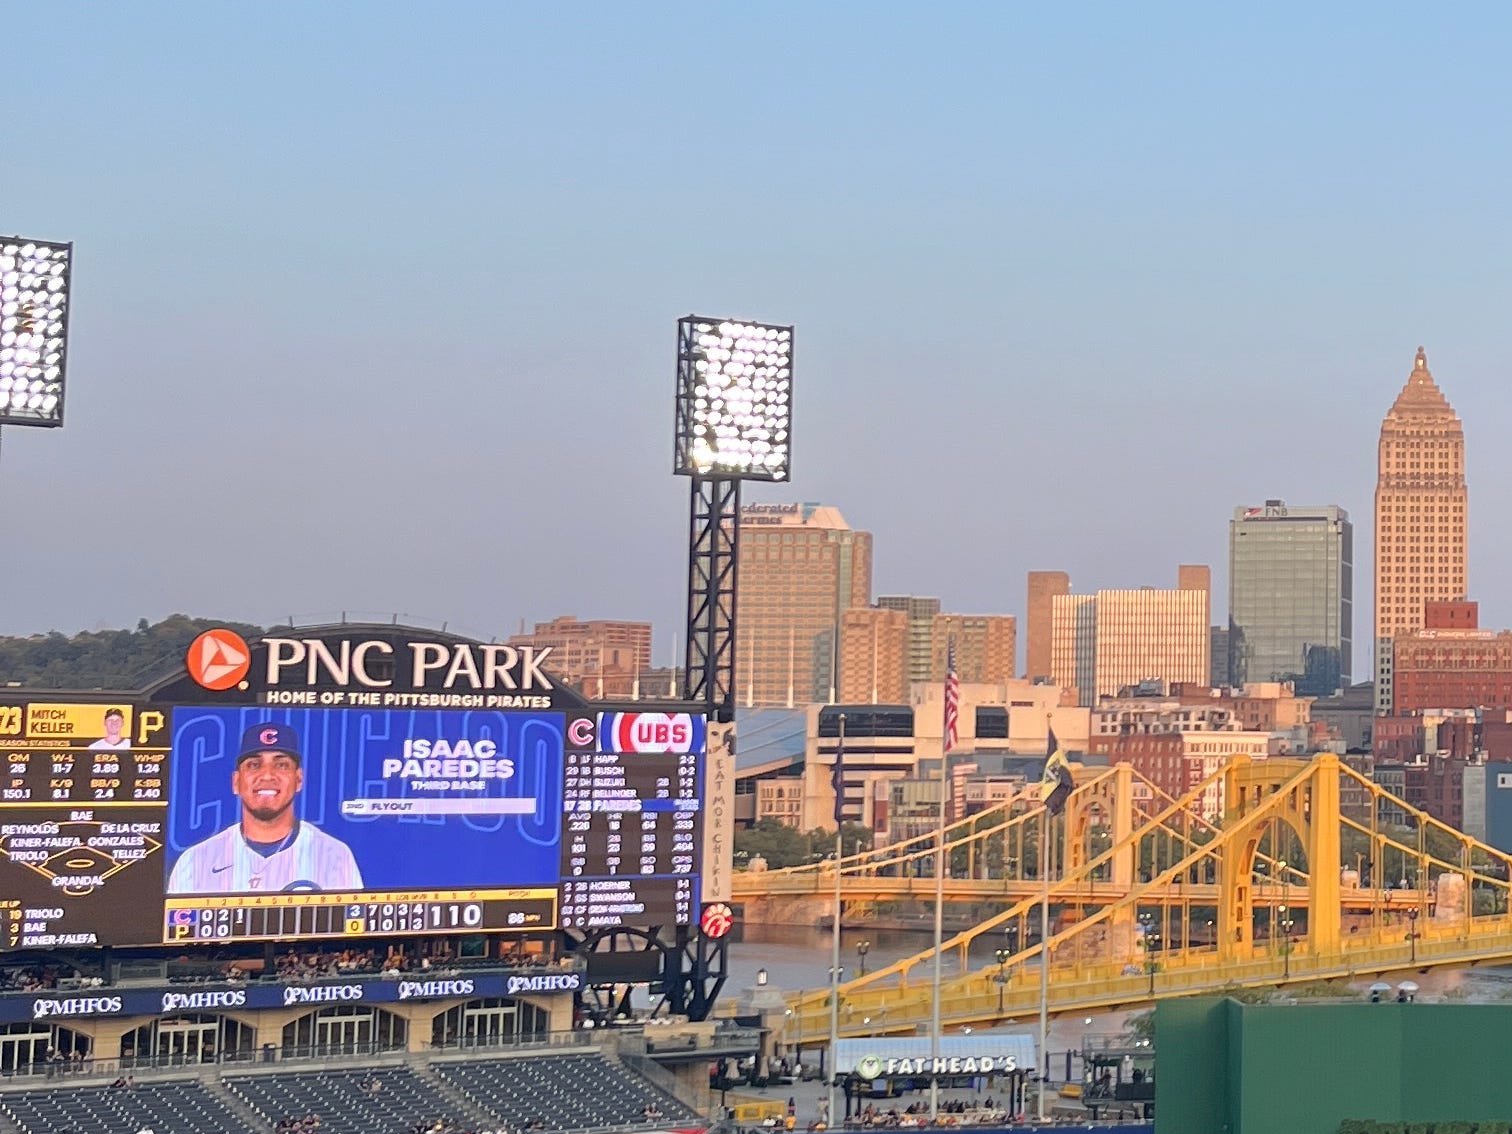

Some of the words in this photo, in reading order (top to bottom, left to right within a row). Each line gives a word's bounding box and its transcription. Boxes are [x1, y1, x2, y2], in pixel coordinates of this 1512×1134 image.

[261, 637, 394, 687] PNC
[407, 641, 554, 690] PARK
[266, 690, 317, 704] HOME
[320, 691, 344, 705] OF
[348, 692, 381, 705] THE
[384, 693, 483, 708] PITTSBURGH
[486, 695, 551, 709] PIRATES
[30, 709, 66, 720] MITCH
[30, 722, 74, 734] KELLER
[138, 710, 165, 744] P
[568, 718, 595, 746] C
[260, 728, 279, 745] C
[403, 739, 497, 758] ISAAC
[8, 753, 30, 763] GM
[94, 753, 118, 763] ERA
[133, 754, 165, 762] WHIP
[593, 755, 619, 763] HAPP
[679, 755, 695, 764] 2-2
[137, 764, 160, 774] 1.24
[382, 759, 515, 778] PAREDES
[565, 767, 579, 775] 29
[593, 766, 625, 775] BUSCH
[678, 766, 695, 775] 0-2
[714, 759, 725, 791] EAT
[410, 780, 450, 790] THIRD
[451, 780, 486, 790] BASE
[565, 778, 579, 787] 27
[593, 778, 626, 787] SUZUKI
[2, 789, 31, 799] 150.1
[94, 789, 114, 799] 2.4
[133, 789, 161, 799] 3.40
[592, 789, 637, 798] BELLINGER
[371, 802, 413, 811] FLYOUT
[712, 797, 725, 827] MOR
[71, 811, 94, 821] BAE
[1, 824, 59, 835] REYNOLDS
[101, 824, 117, 834] DE
[117, 824, 130, 833] LA
[132, 823, 161, 833] CRUZ
[10, 837, 81, 847] KINER-FALEFA
[87, 836, 145, 846] GONZALES
[9, 851, 49, 861] TRIOLO
[112, 849, 147, 859] TELLEZ
[51, 876, 105, 886] GRANDAL
[564, 882, 572, 891] 2
[588, 892, 636, 903] SWANSON
[25, 909, 64, 919] TRIOLO
[174, 909, 192, 924] C
[201, 909, 213, 922] 0
[218, 909, 229, 921] 2
[235, 909, 243, 924] 1
[350, 905, 360, 916] 3
[369, 904, 378, 916] 7
[383, 904, 393, 916] 0
[398, 904, 409, 915] 3
[412, 904, 424, 915] 4
[430, 905, 441, 926] 1
[449, 905, 459, 926] 1
[463, 904, 481, 925] 0
[587, 916, 622, 926] AMAYA
[10, 923, 19, 933] 3
[23, 922, 47, 932] BAE
[175, 925, 190, 940] P
[201, 925, 212, 937] 0
[217, 924, 229, 937] 0
[350, 920, 359, 931] 0
[369, 919, 376, 930] 1
[382, 919, 394, 930] 0
[399, 919, 407, 930] 1
[10, 936, 19, 946] 7
[22, 933, 98, 946] KINER-FALEFA
[887, 1058, 926, 1075] FAT
[932, 1055, 1017, 1074] HEAD'S
